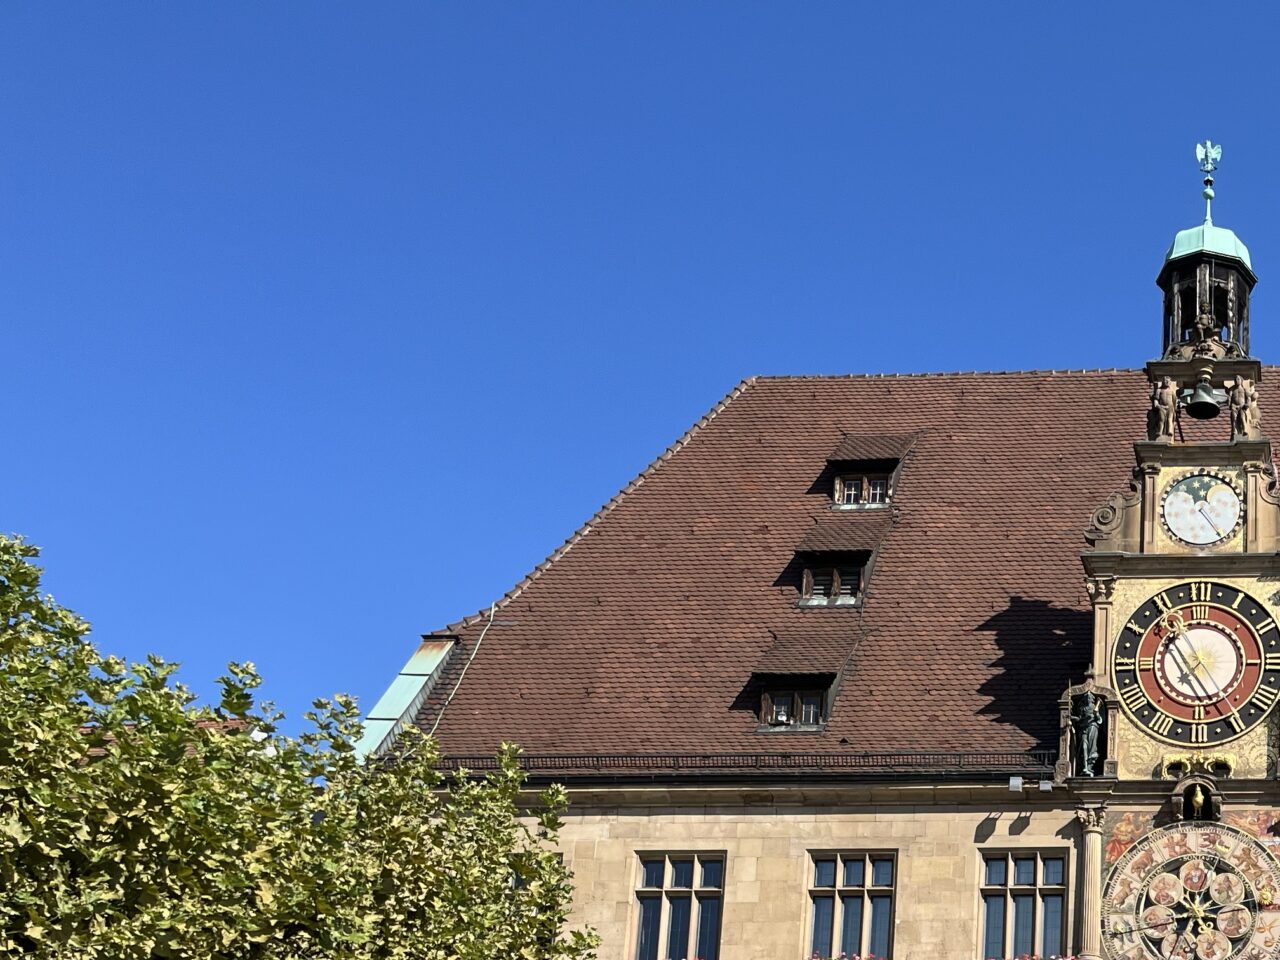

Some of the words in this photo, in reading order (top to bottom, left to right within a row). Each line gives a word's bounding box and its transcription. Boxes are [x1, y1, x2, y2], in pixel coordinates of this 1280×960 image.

[1190, 583, 1212, 601] XII
[1232, 592, 1245, 609] I
[1192, 606, 1209, 619] IIII
[1126, 619, 1145, 635] X
[1256, 617, 1276, 635] II
[1139, 657, 1154, 669] III
[1251, 684, 1278, 710] IIII
